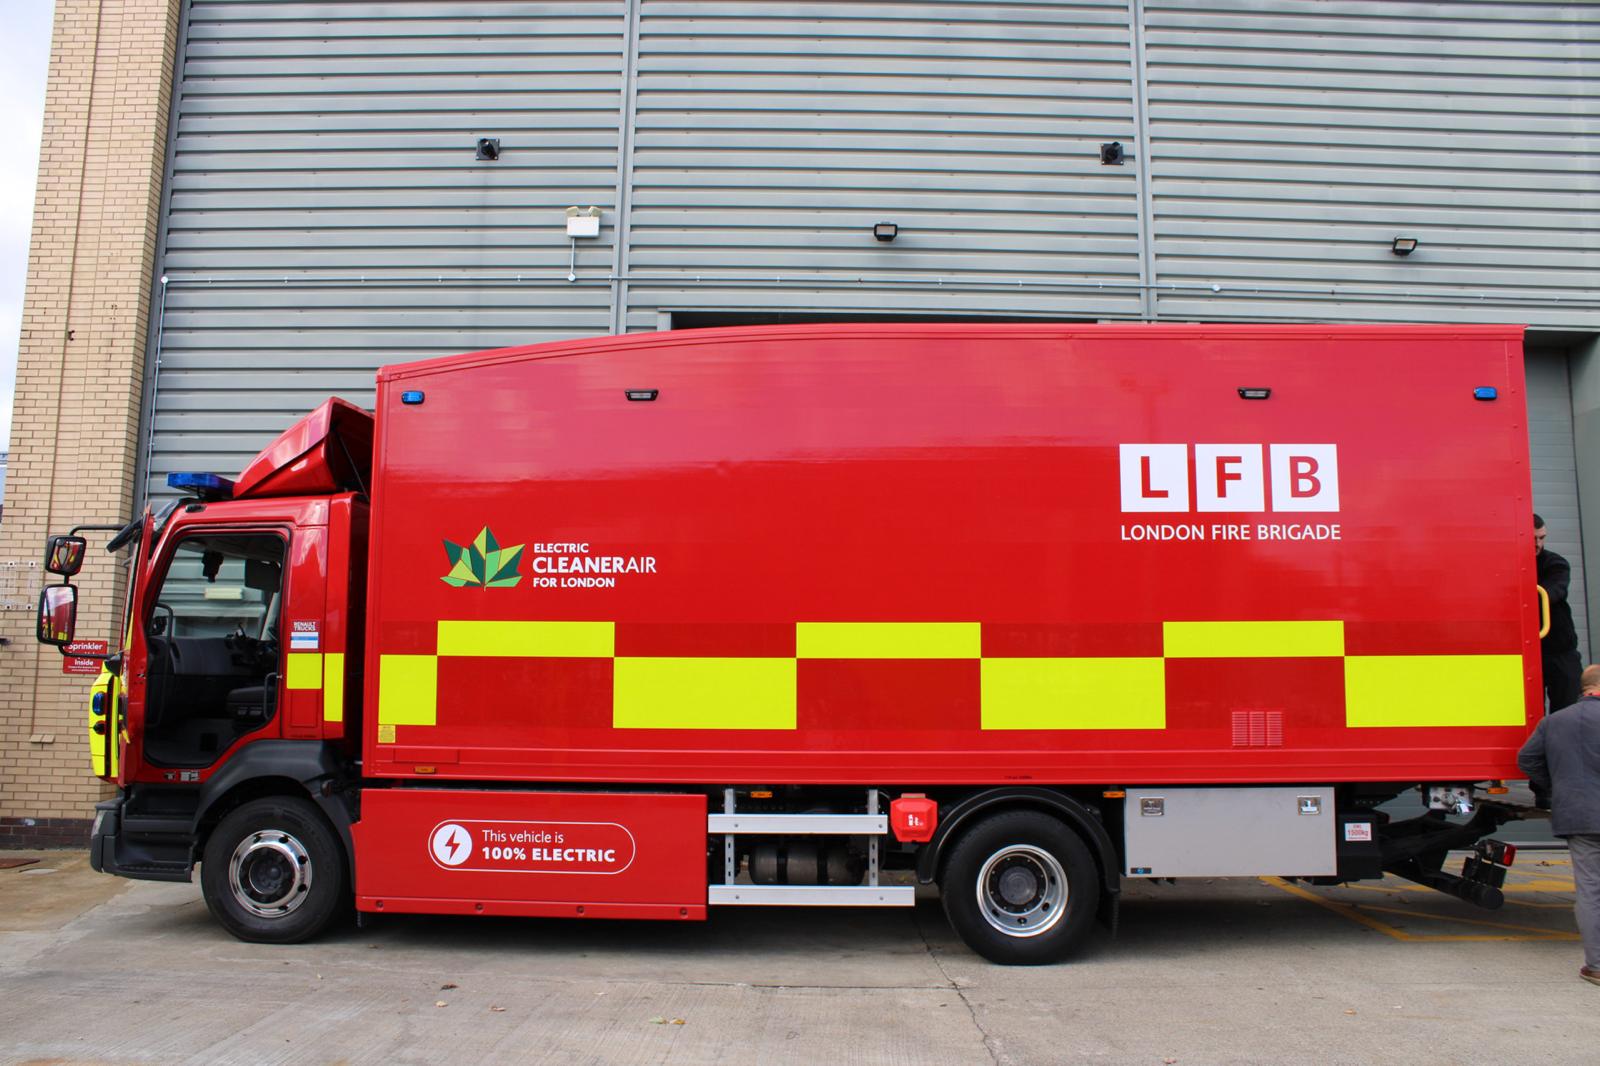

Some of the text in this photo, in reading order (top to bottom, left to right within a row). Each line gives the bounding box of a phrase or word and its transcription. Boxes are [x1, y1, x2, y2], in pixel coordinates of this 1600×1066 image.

[1121, 524, 1342, 541] LONDON FIRE BRIGADE
[533, 543, 589, 553] ELECTRIC
[533, 577, 615, 588] FOR LONDON
[74, 658, 94, 666] Inside
[482, 829, 564, 844] This vehicle is
[482, 847, 616, 862] 100% ELECTRIC
